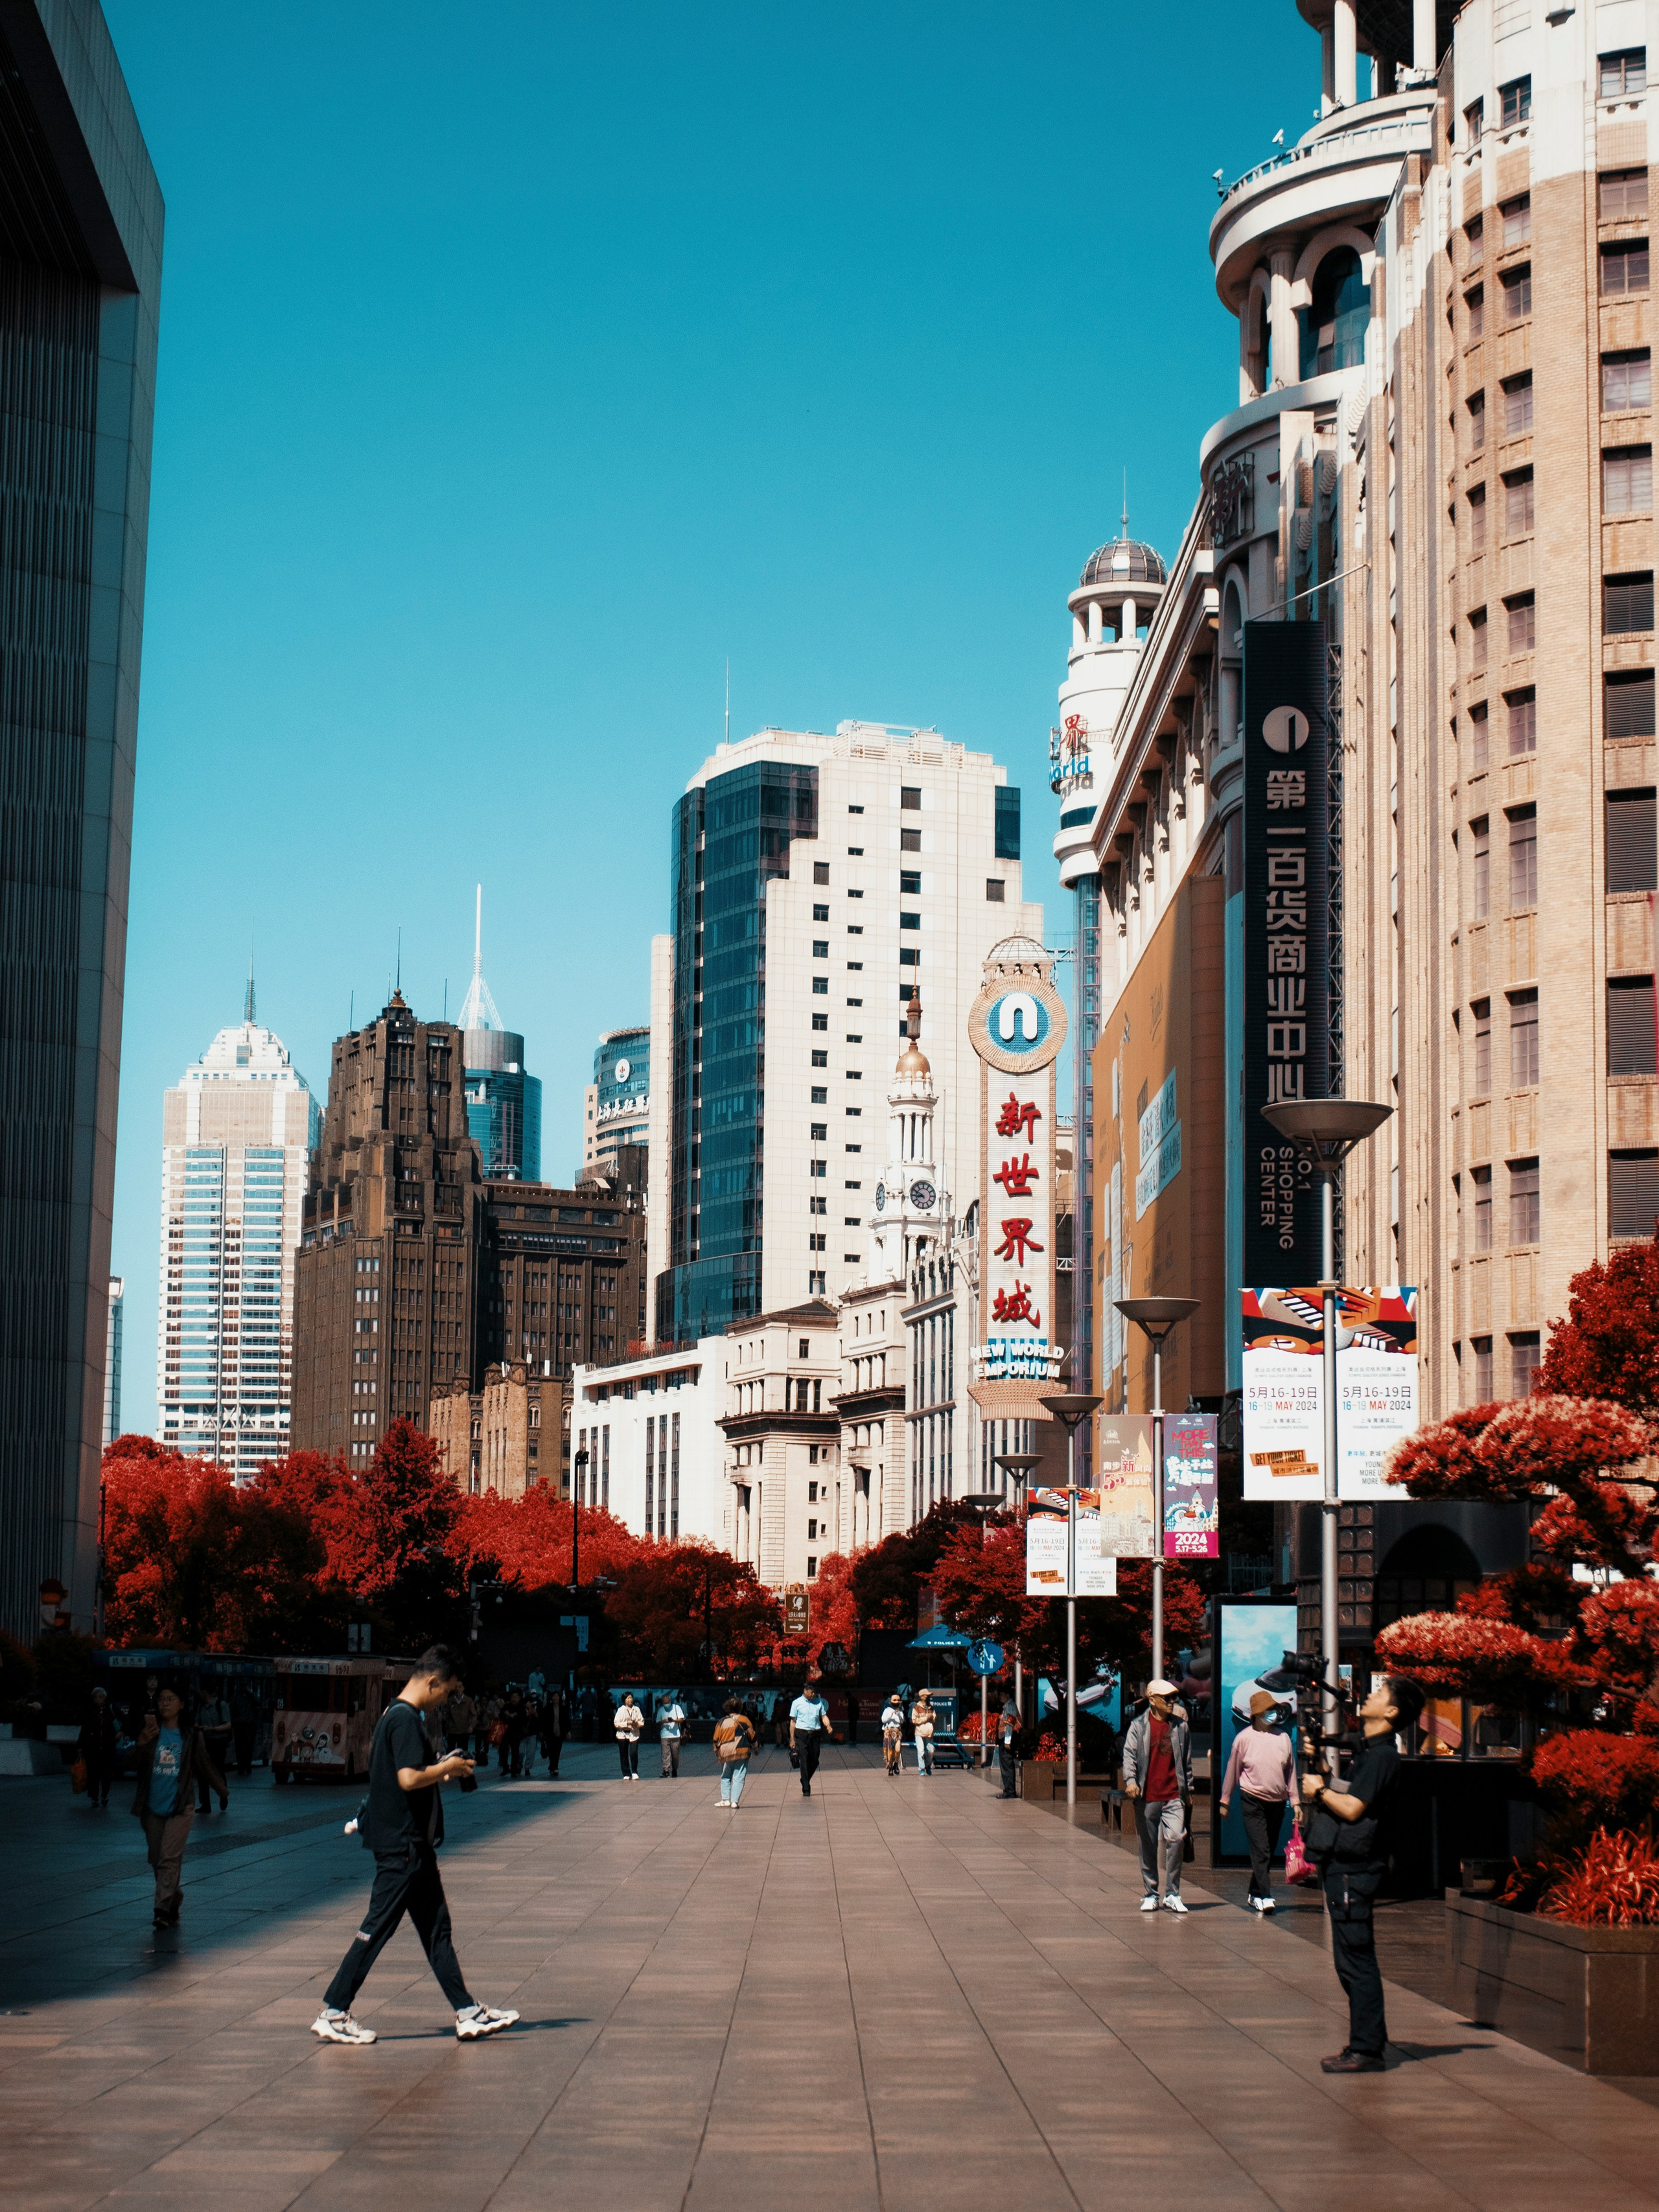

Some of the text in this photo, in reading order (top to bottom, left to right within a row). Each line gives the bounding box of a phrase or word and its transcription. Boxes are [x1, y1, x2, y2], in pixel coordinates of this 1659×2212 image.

[1267, 770, 1306, 1101] 第一百货商业中心
[1261, 1147, 1275, 1226] CENTER
[1279, 1147, 1294, 1249] SHOPPING
[992, 1091, 1044, 1329] 新世界城
[970, 1343, 1064, 1359] NEW WORLD
[974, 1362, 1060, 1379] EMPORIUM
[1249, 1386, 1317, 1399] 5月16-19日
[1343, 1386, 1411, 1398] 5月16-19日
[1275, 1401, 1293, 1410] MAY
[1295, 1401, 1317, 1410] 2024
[1369, 1401, 1387, 1410] MAY
[1389, 1401, 1411, 1410] 2024
[1171, 1428, 1210, 1443] MORE
[1178, 1449, 1206, 1459] THIS
[1255, 1450, 1305, 1465] GET YOUR TICKET
[1175, 1533, 1208, 1544] 2024
[1175, 1544, 1208, 1553] 5.17-5.26
